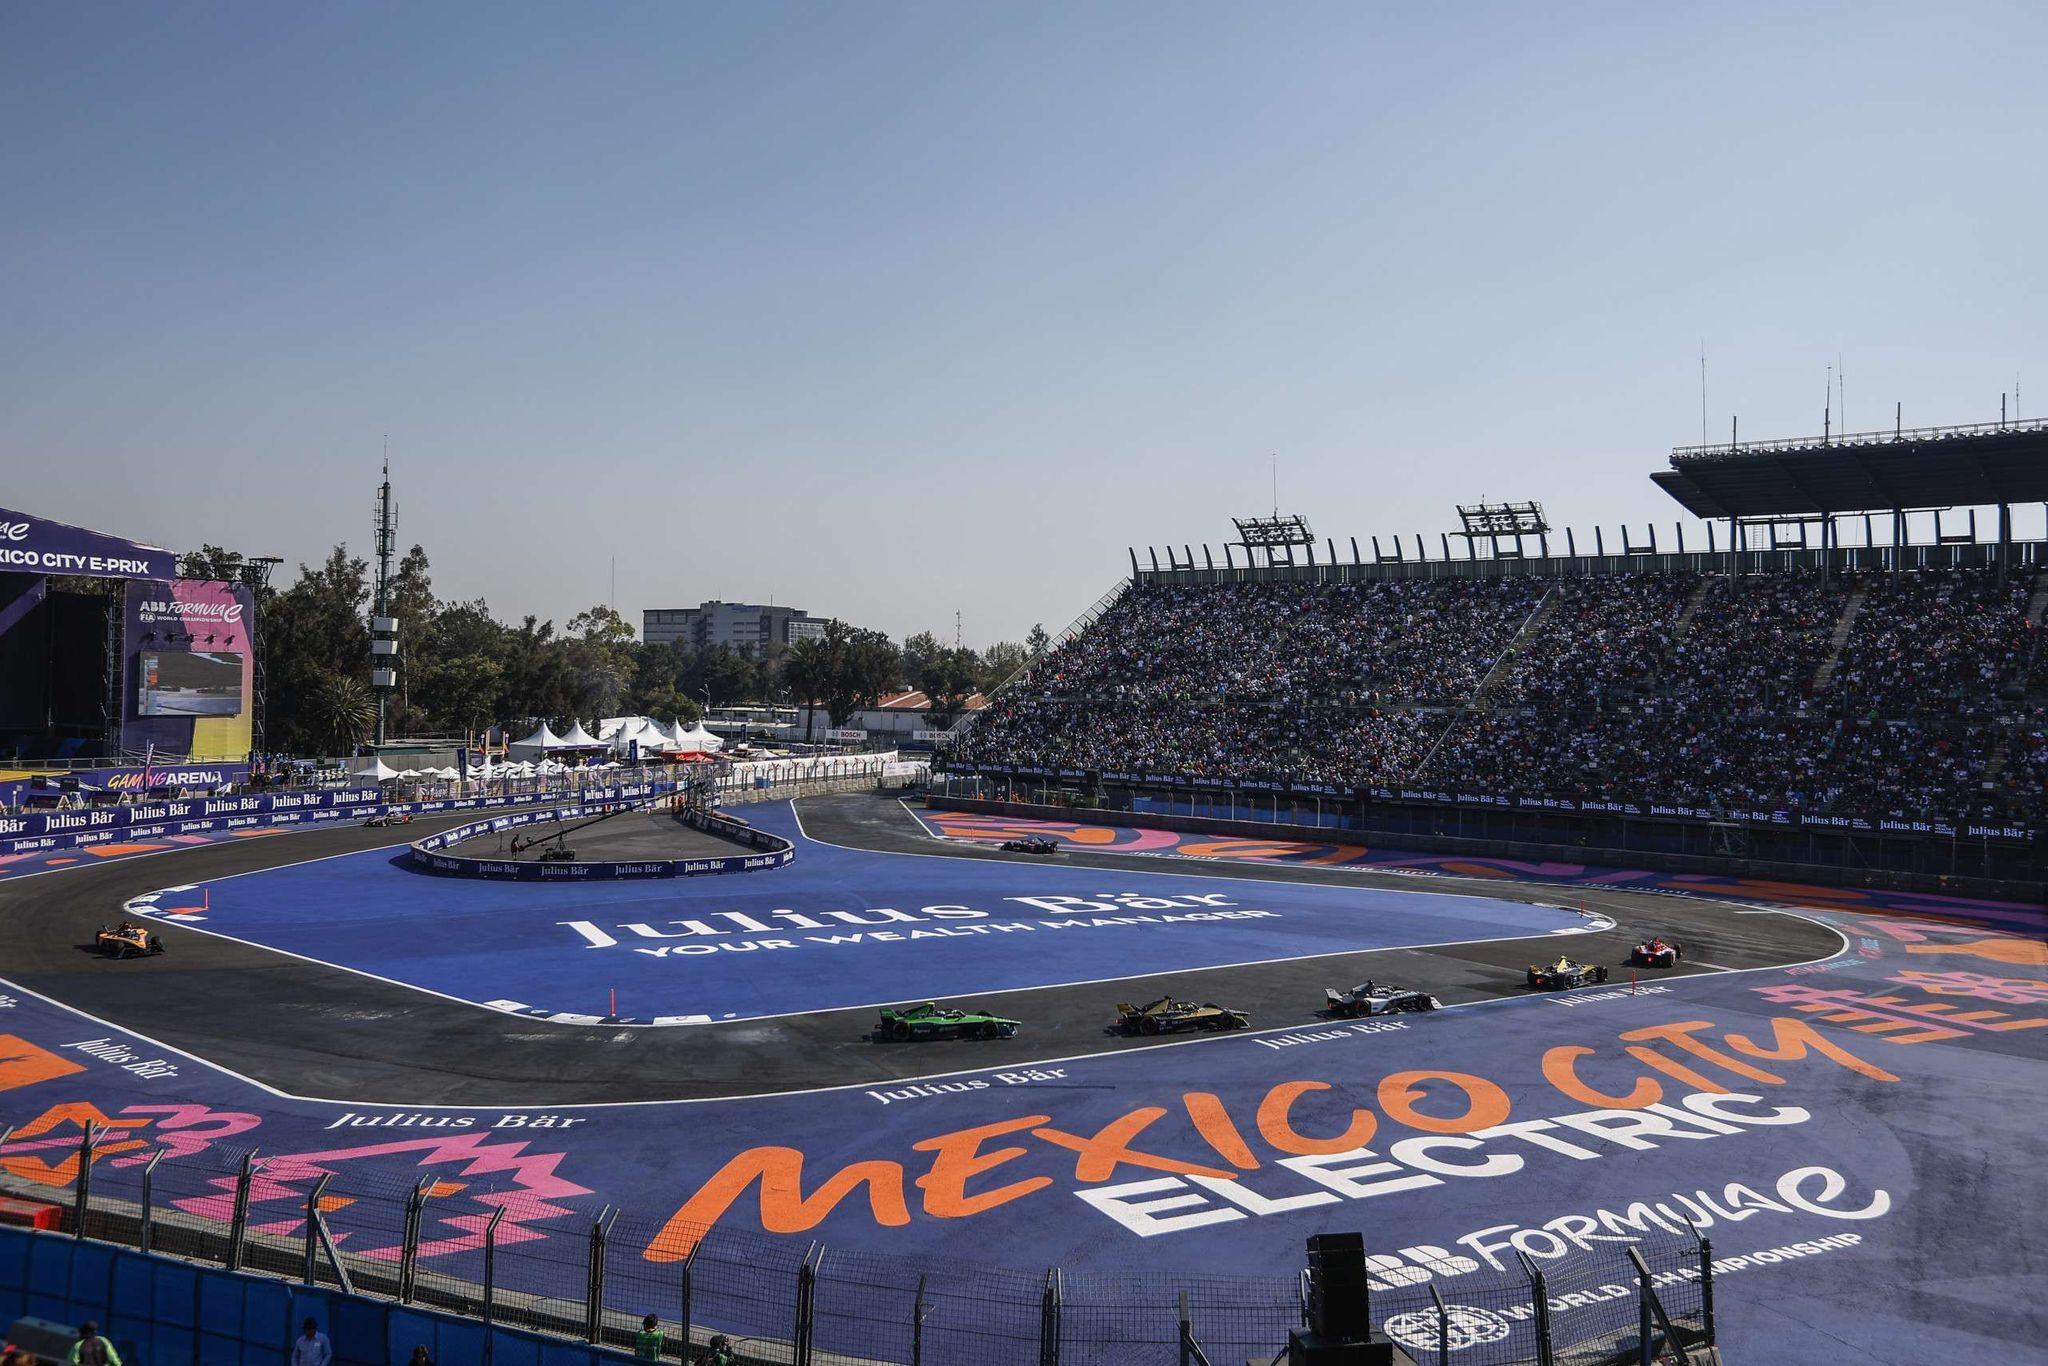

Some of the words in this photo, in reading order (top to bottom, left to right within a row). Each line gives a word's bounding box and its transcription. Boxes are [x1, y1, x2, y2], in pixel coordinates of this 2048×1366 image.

[43, 553, 87, 569] CITY
[90, 557, 149, 574] E-PRIX
[140, 601, 167, 613] ABB
[167, 602, 226, 614] FORMULA
[841, 731, 861, 739] BOSCH
[166, 771, 223, 785] ARENA
[272, 795, 301, 809] Julius
[303, 793, 322, 805] Bär
[332, 792, 360, 805] Julius
[361, 790, 378, 801] Bär
[1401, 790, 1422, 799] Julius
[1423, 791, 1436, 799] Bär
[1457, 793, 1479, 802] Julius
[1480, 794, 1495, 803] Bär
[205, 800, 238, 815] Julius
[240, 798, 260, 810] Bär
[1519, 797, 1542, 806] Julius
[1543, 798, 1559, 807] Bär
[1582, 801, 1606, 810] Julius
[1607, 802, 1623, 811] Bär
[130, 806, 166, 823] Julius
[169, 804, 191, 817] Bär
[313, 811, 329, 819] Julius
[329, 810, 340, 818] Bär
[352, 808, 367, 817] Julius
[367, 806, 377, 814] Bär
[1650, 805, 1676, 815] Julius
[1678, 807, 1694, 816] Bär
[1752, 811, 1769, 821] Bär
[45, 815, 87, 833] Julius
[90, 811, 115, 826] Bär
[227, 818, 247, 828] Julius
[246, 817, 258, 825] Bär
[271, 814, 290, 824] Julius
[290, 813, 301, 821] Bär
[1801, 814, 1829, 825] Julius
[1831, 816, 1850, 826] Bär
[0, 819, 27, 833] Bär
[181, 823, 200, 833] Julius
[200, 820, 213, 829] Bär
[1880, 819, 1910, 831] Julius
[1912, 821, 1933, 832] Bär
[1968, 825, 2000, 836] Julius
[2003, 827, 2025, 838] Bär
[75, 834, 99, 845] Julius
[99, 832, 114, 842] Bär
[130, 828, 152, 839] Julius
[152, 826, 165, 835] Bär
[14, 840, 39, 852] Julius
[40, 838, 56, 848] Bär
[479, 863, 502, 874] Julius
[504, 864, 520, 874] Bär
[685, 862, 709, 872] Julius
[710, 860, 726, 870] Bär
[744, 858, 764, 869] Julius
[764, 856, 775, 865] Bär
[541, 865, 568, 876] Julius
[571, 866, 589, 875] Bär
[616, 864, 642, 876] Julius
[644, 863, 662, 873] Bär
[555, 905, 990, 949] Julius
[1003, 892, 1239, 914] Bär
[633, 939, 800, 958] YOUR
[804, 922, 1036, 945] WEALTH
[1038, 910, 1283, 929] MANAGER
[1252, 1027, 1352, 1050] Julius
[1360, 1019, 1414, 1036] Bär
[60, 1037, 132, 1065] Julius
[122, 1059, 179, 1080] Bär
[865, 1079, 991, 1105] Julius
[992, 1068, 1068, 1085] Bär
[324, 1113, 477, 1131] Julius
[491, 1114, 587, 1129] Bär
[642, 1070, 1511, 1262] MEXICO
[1542, 1017, 1901, 1109] CITY
[1073, 1092, 1811, 1237] ELECTRIC
[1456, 1183, 1794, 1272] FORMULA
[1497, 1284, 1632, 1320] WORLD
